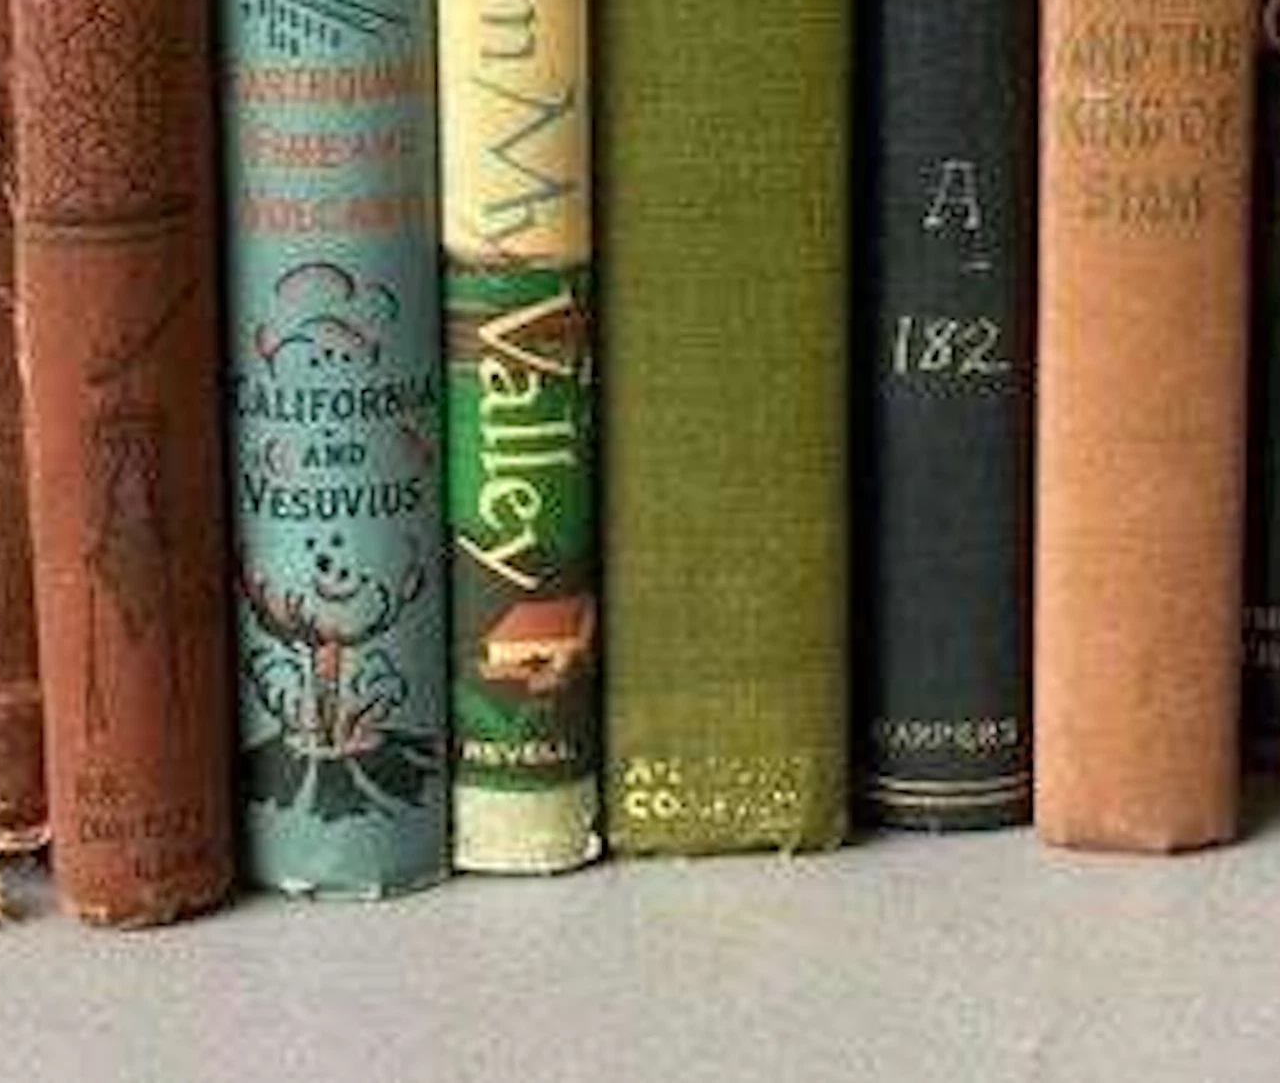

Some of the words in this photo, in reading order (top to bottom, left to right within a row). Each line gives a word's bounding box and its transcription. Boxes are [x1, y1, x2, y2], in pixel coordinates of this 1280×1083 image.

[922, 159, 982, 231] A
[1082, 174, 1206, 227] SIAM
[301, 443, 366, 468] AND
[456, 290, 577, 591] Valley
[239, 474, 422, 520] VESUVIUS
